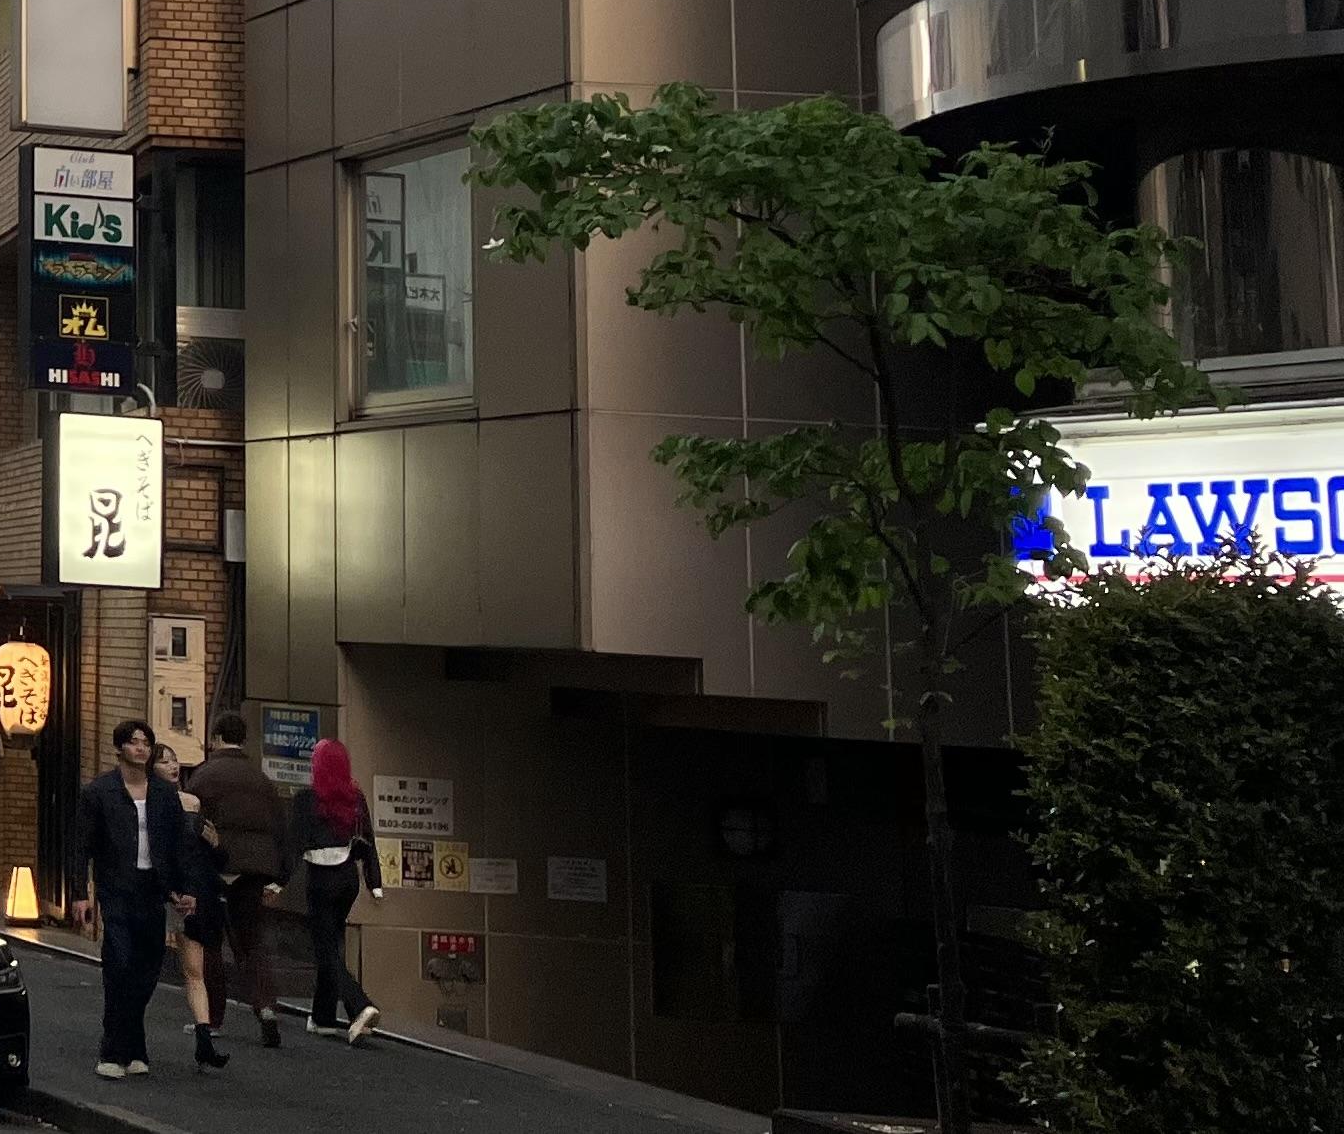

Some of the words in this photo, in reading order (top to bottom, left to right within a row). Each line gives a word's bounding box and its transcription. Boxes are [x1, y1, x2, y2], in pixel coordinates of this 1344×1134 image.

[62, 316, 106, 337] オム
[48, 368, 120, 388] HISASHI
[135, 434, 154, 521] へぎそば
[18, 656, 39, 725] へぎそば
